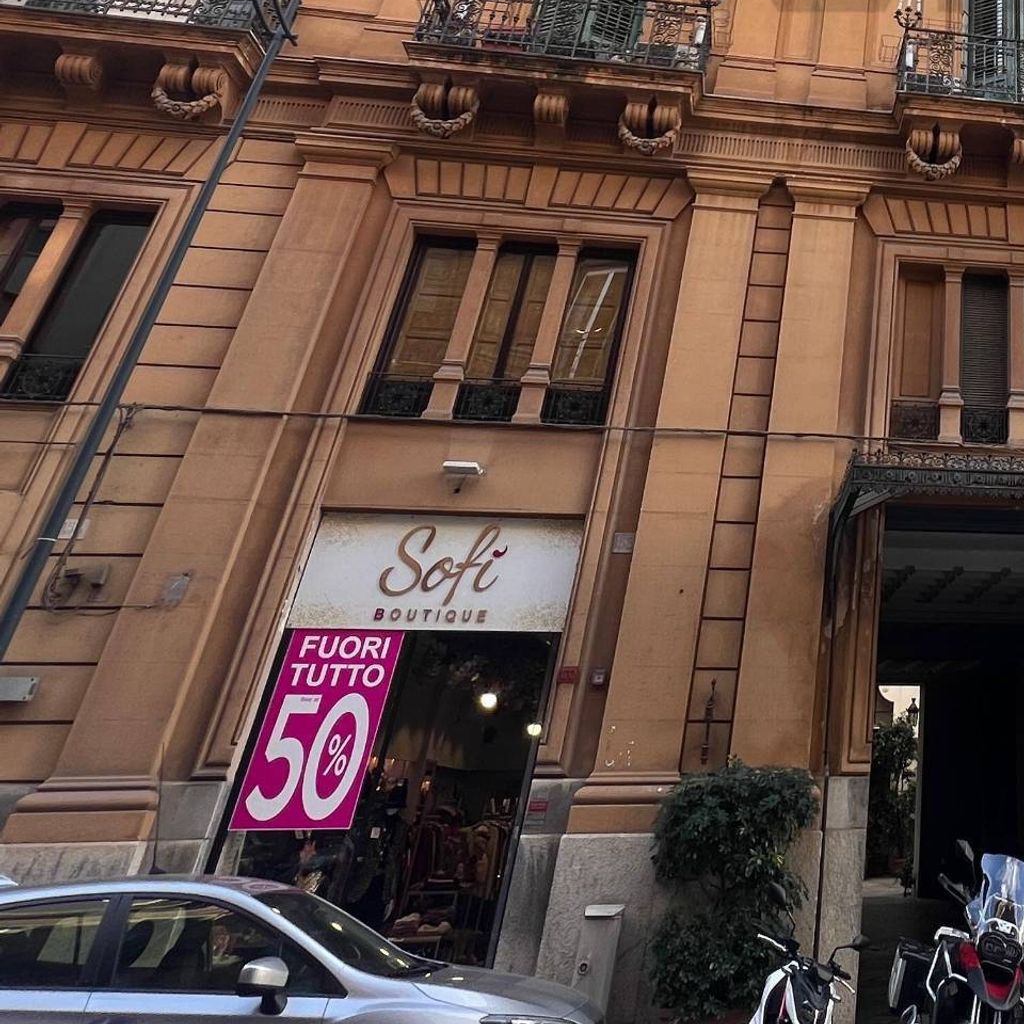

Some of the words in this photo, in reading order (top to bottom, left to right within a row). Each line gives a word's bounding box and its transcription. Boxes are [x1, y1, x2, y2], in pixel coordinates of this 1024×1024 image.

[379, 524, 508, 606] Sofi
[373, 608, 488, 623] BOUTIQUE
[299, 635, 391, 659] FUORI
[291, 663, 385, 687] TUTTO
